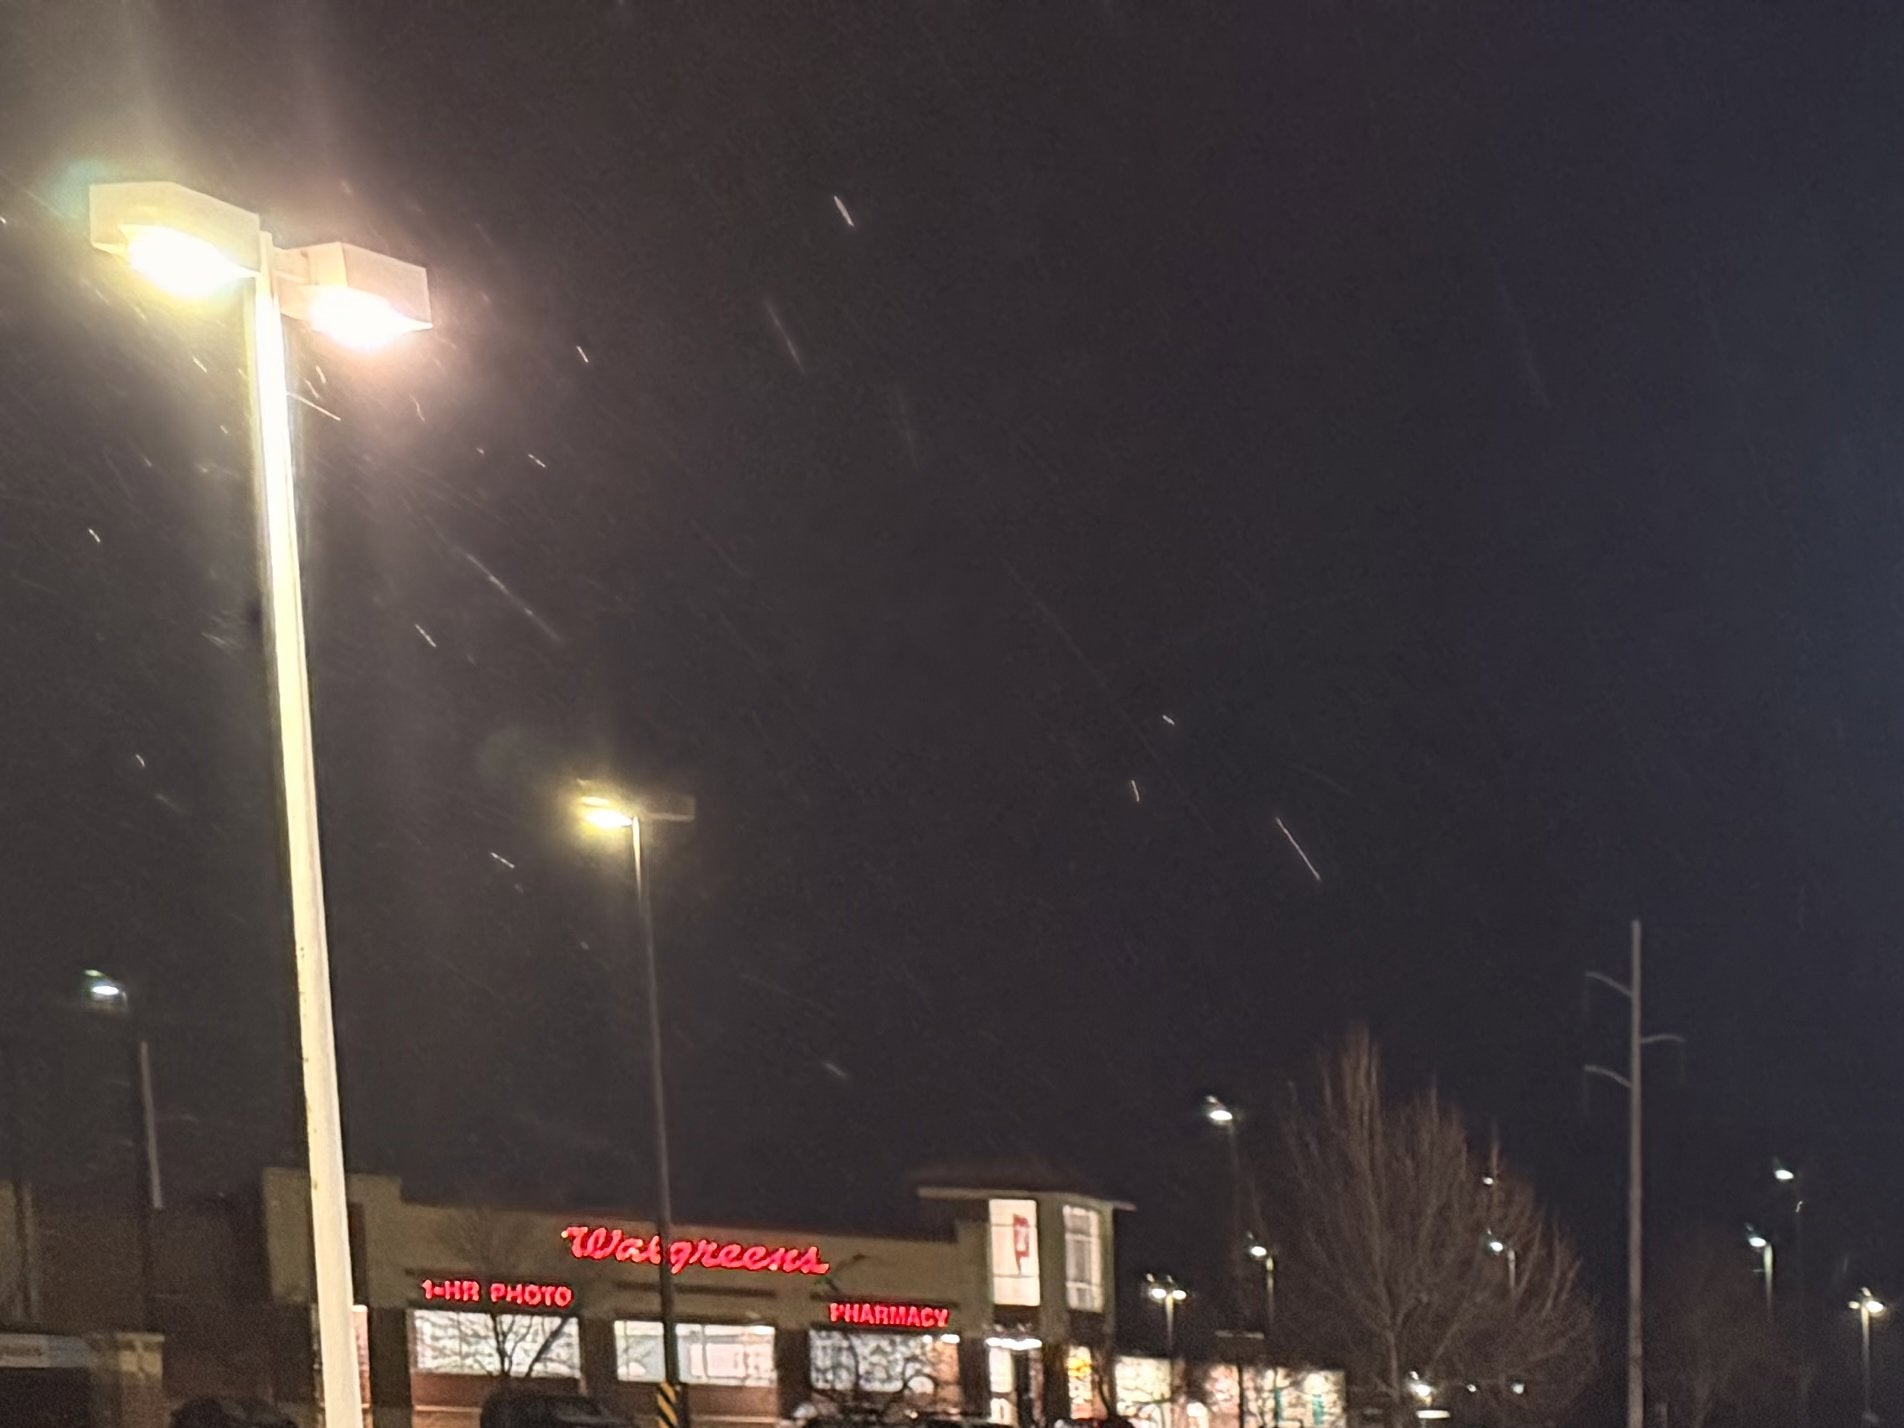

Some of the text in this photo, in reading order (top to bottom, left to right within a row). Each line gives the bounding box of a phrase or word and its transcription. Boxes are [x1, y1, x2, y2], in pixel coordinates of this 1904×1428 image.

[561, 1226, 830, 1274] Walgreens
[421, 1279, 573, 1307] 1-HR PHOTO
[829, 1302, 949, 1328] PHARMACY
